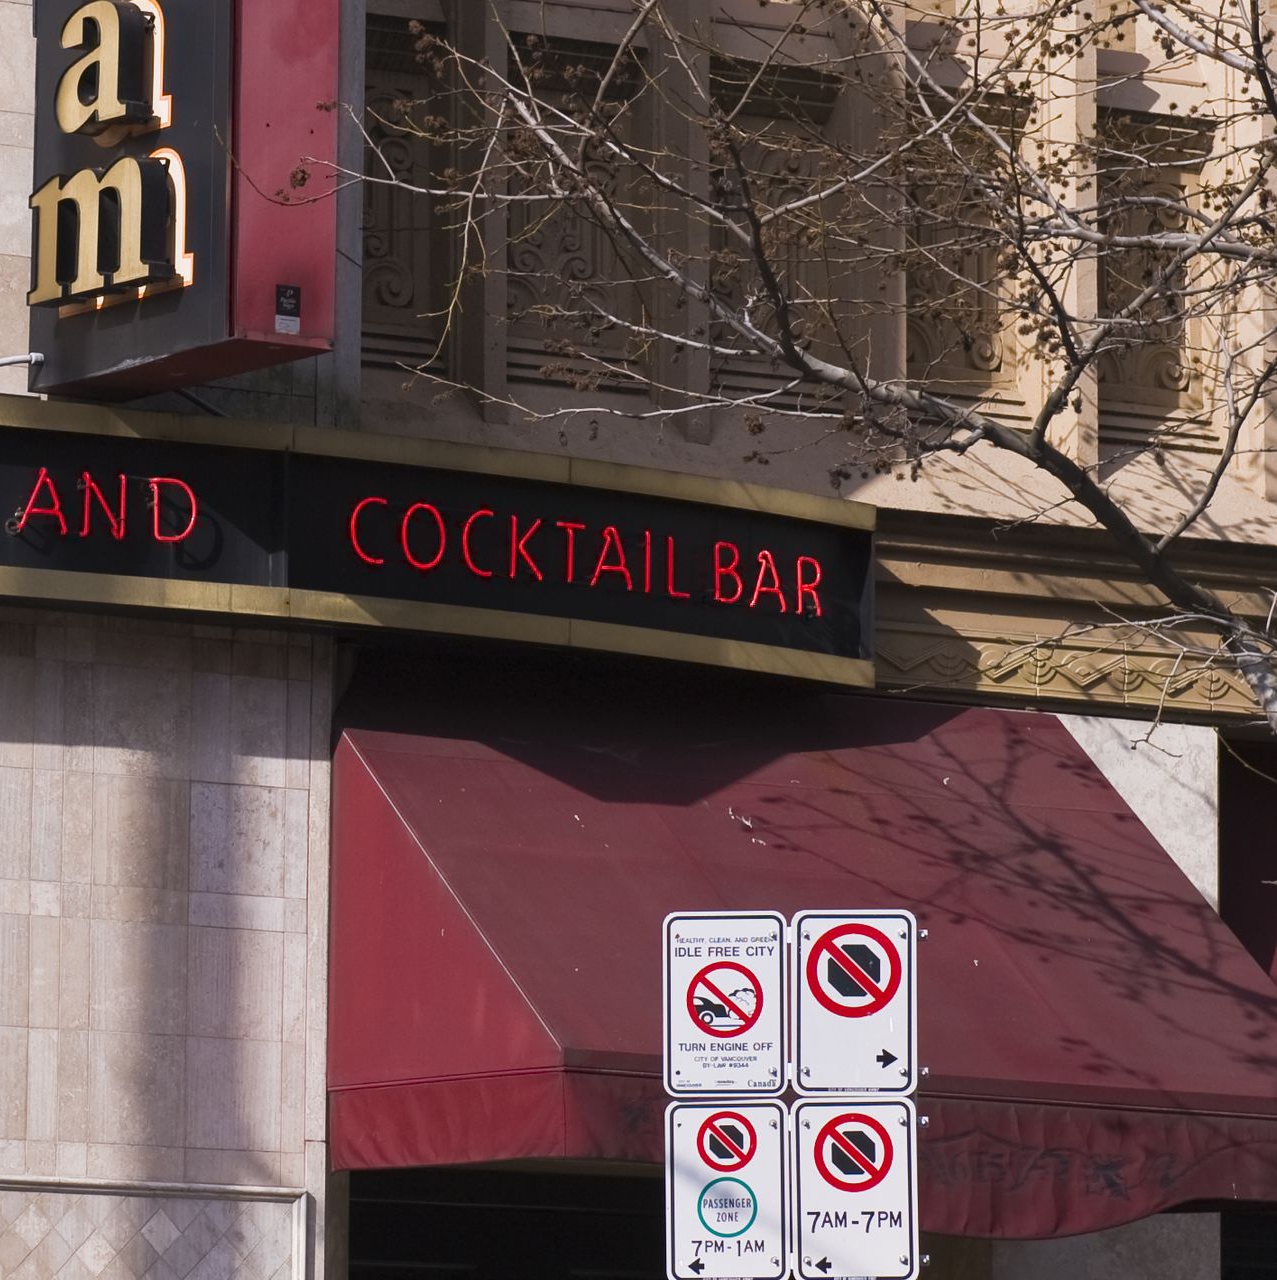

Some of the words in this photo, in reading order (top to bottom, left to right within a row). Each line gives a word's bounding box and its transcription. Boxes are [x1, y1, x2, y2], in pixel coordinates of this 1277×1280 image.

[17, 467, 197, 542] AND
[350, 497, 691, 598] COCKTAIL
[714, 541, 823, 617] BAR
[674, 946, 702, 958] IDLE
[707, 946, 740, 958] FREE
[745, 945, 775, 957] CITY
[678, 1042, 706, 1052] TURN
[710, 1042, 749, 1052] ENGINE
[752, 1042, 774, 1052] OFF
[702, 1197, 752, 1209] PASSENGER
[716, 1211, 739, 1223] ZONE
